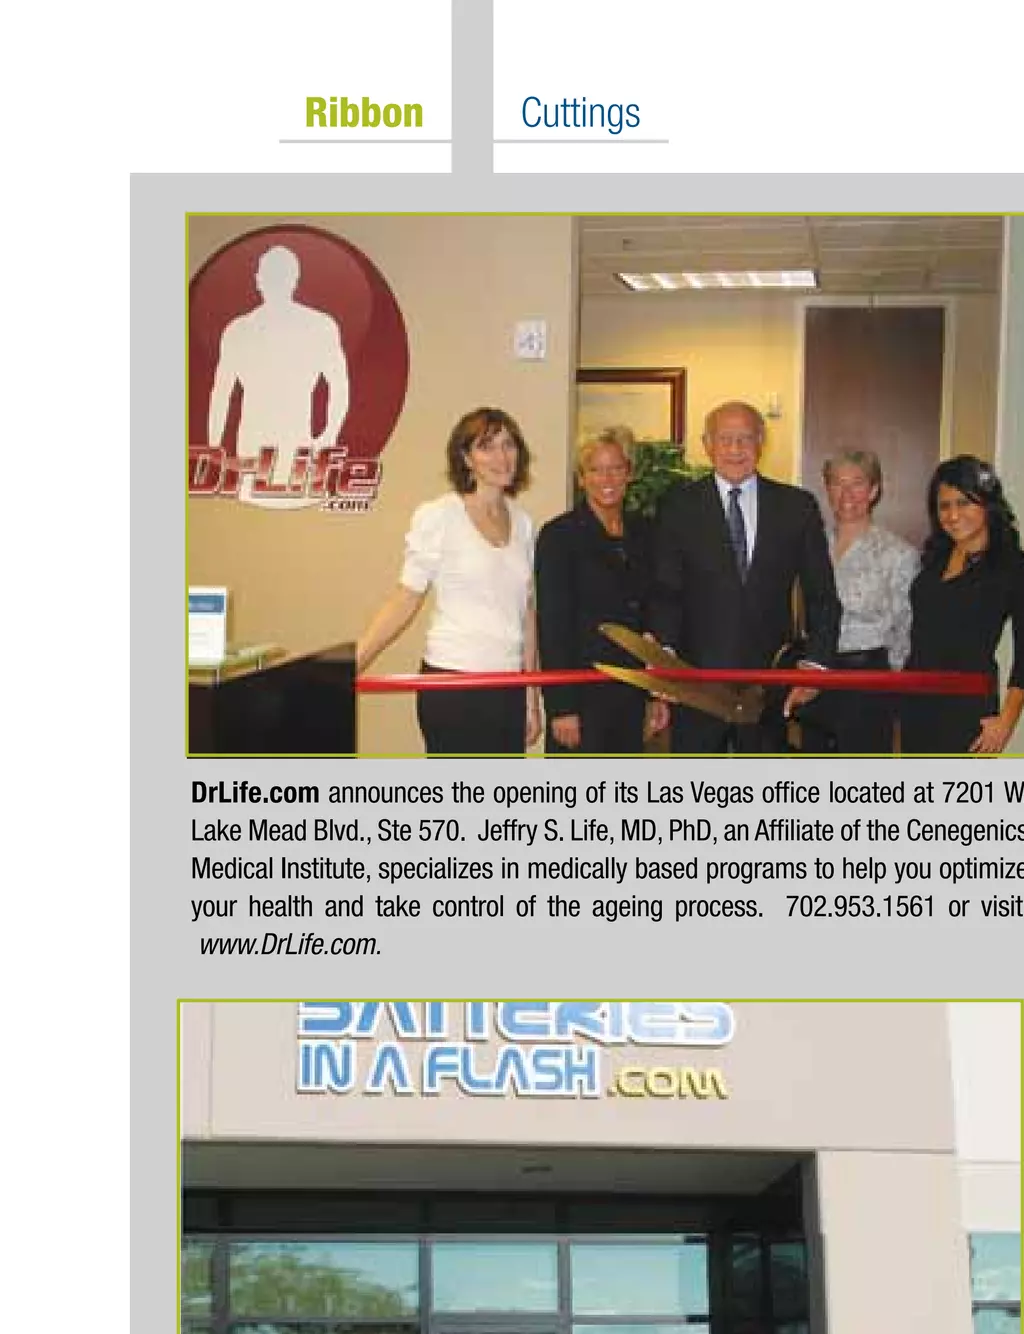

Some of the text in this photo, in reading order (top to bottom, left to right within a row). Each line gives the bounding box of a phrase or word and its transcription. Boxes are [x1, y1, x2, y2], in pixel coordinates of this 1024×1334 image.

[306, 96, 423, 128] Ribbon
[522, 96, 640, 135] Cuttings
[192, 781, 319, 803] DrLife.com
[329, 786, 443, 803] announces
[451, 781, 484, 803] the
[494, 781, 576, 808] opening
[586, 781, 606, 803] of
[615, 781, 638, 803] its
[648, 781, 683, 803] Las
[690, 781, 754, 808] Vegas
[762, 781, 820, 803] office
[830, 781, 904, 803] located
[914, 782, 934, 803] at
[943, 781, 992, 803] 7201
[192, 857, 273, 879] Medical
[282, 857, 370, 883] Institute,
[379, 857, 493, 884] specializes
[502, 857, 518, 879] in
[528, 857, 627, 884] medically
[636, 857, 697, 879] based
[707, 862, 807, 884] programs
[814, 858, 834, 879] to
[843, 857, 886, 884] help
[894, 862, 931, 884] you
[201, 933, 380, 955] www.DrLife.com.
[298, 1042, 355, 1093] IN
[365, 1043, 415, 1094] A
[423, 1043, 600, 1098] FLASH
